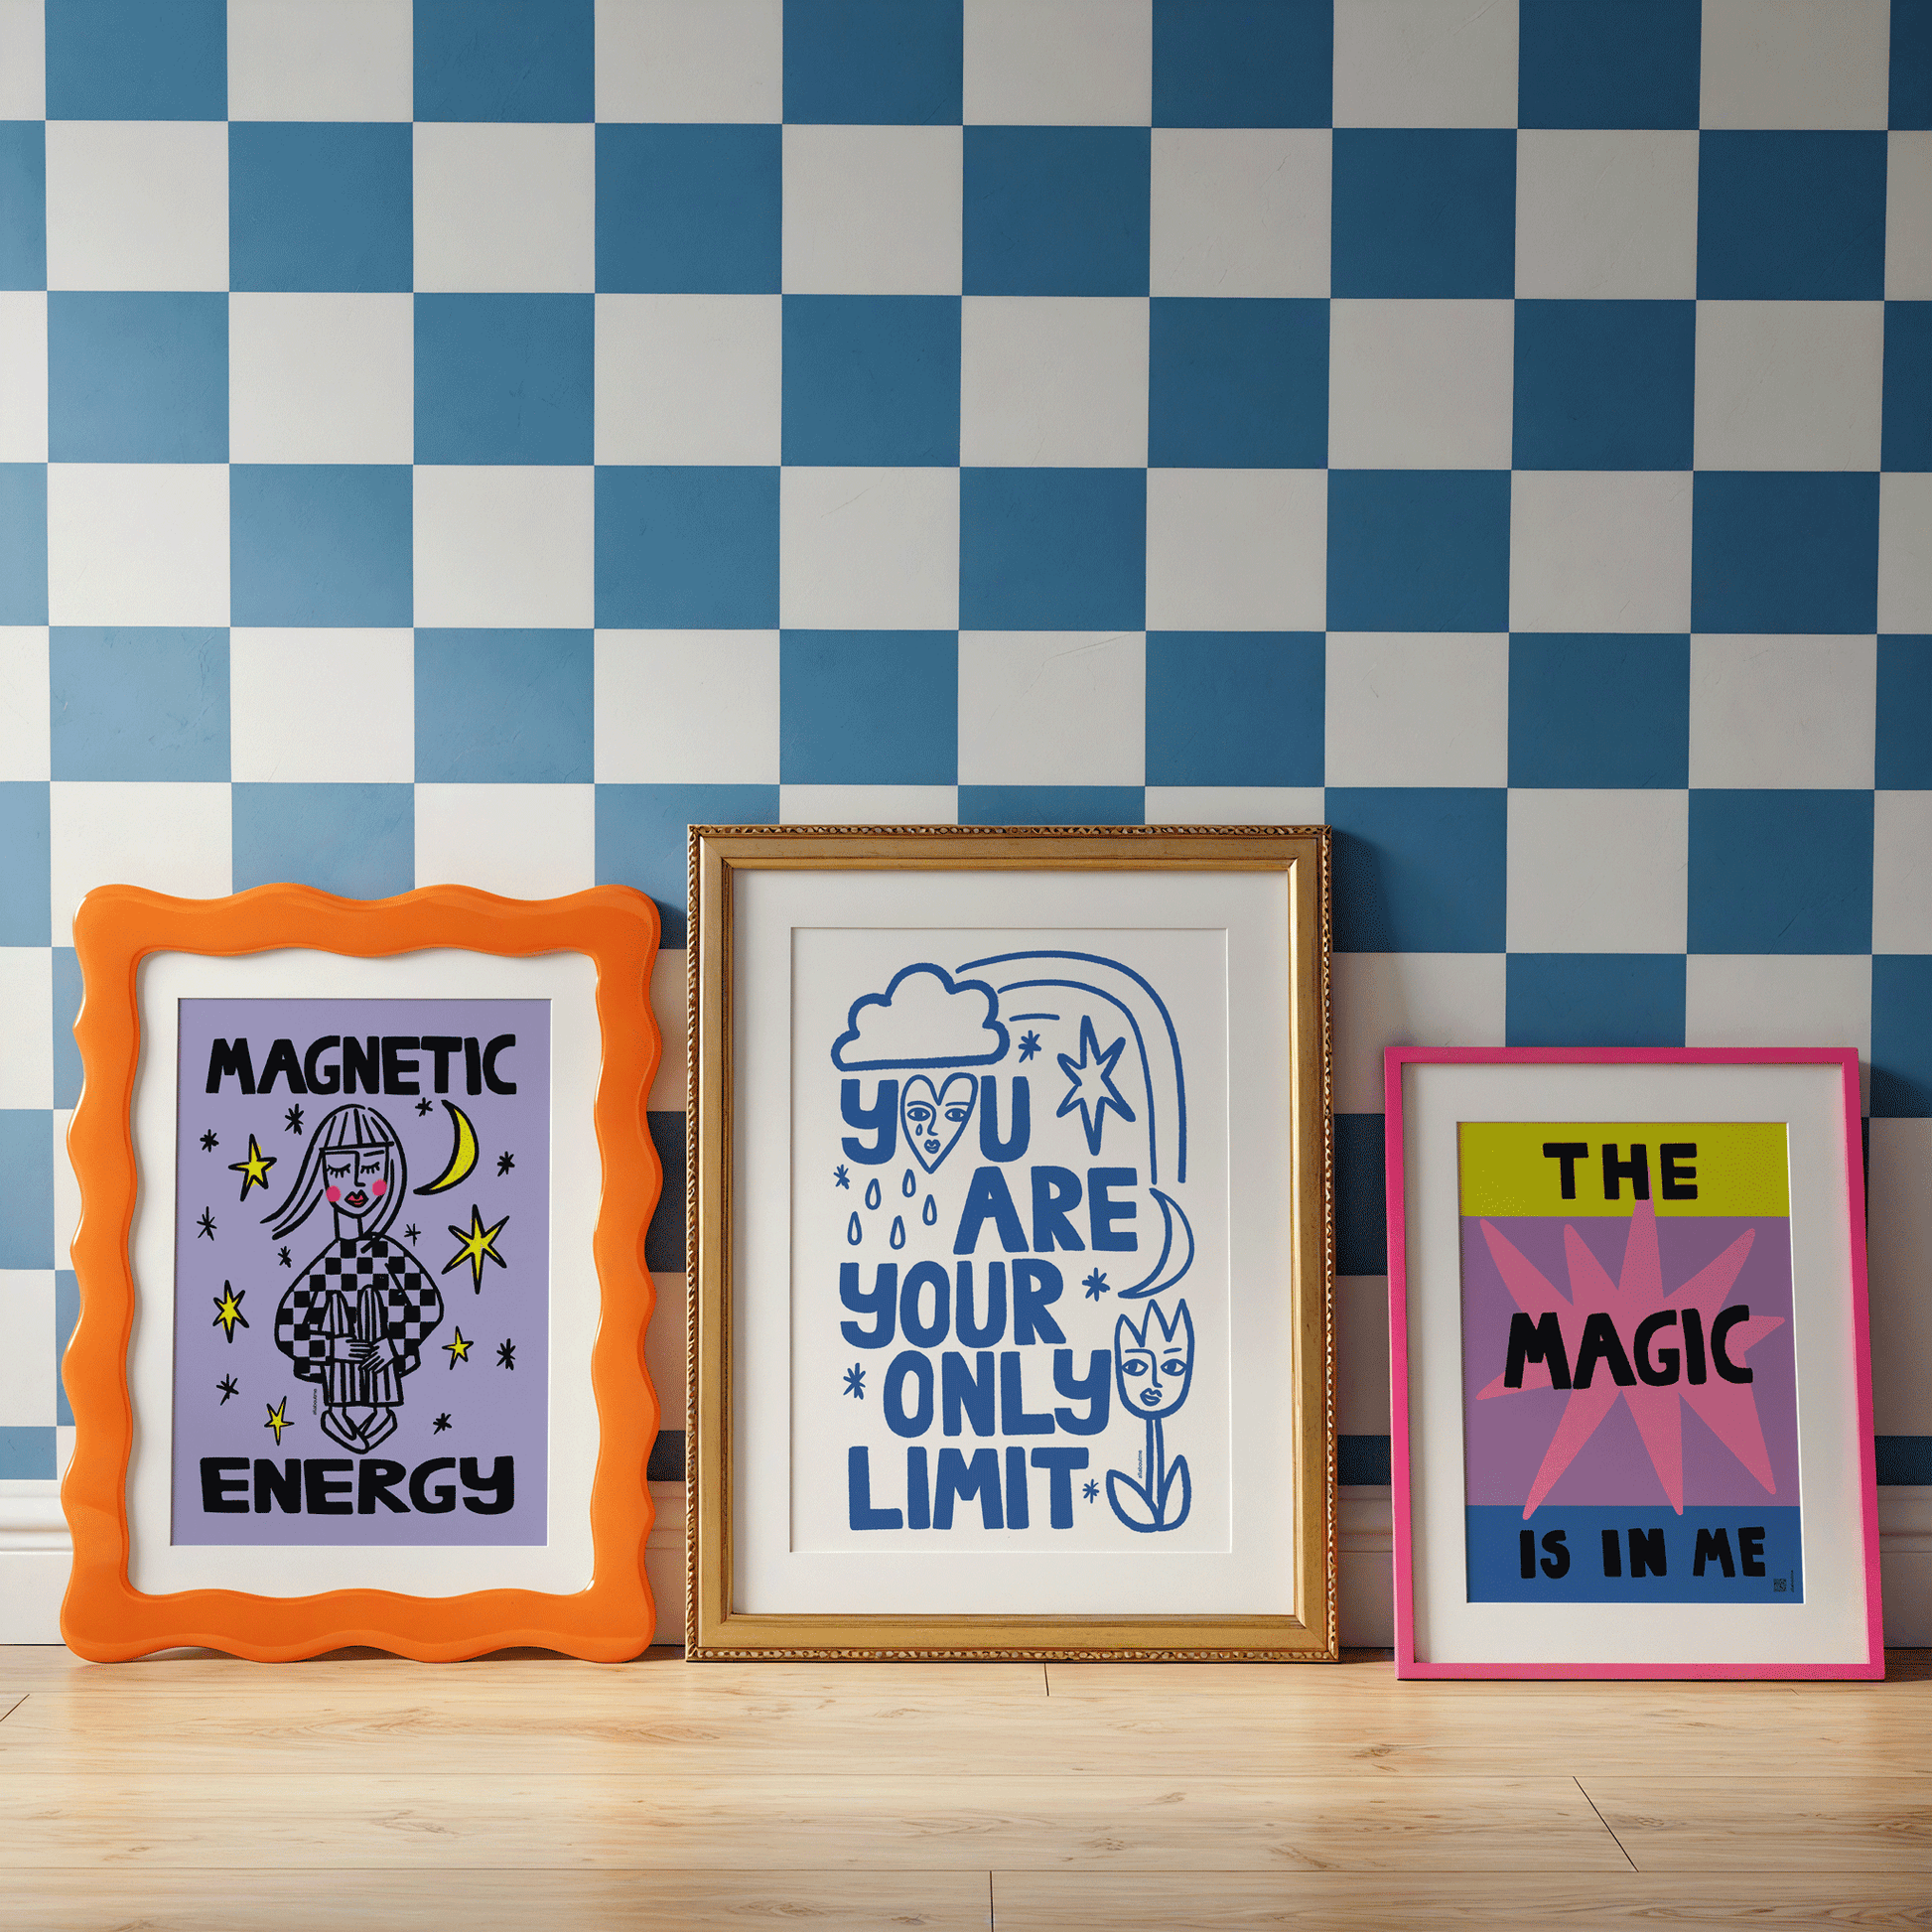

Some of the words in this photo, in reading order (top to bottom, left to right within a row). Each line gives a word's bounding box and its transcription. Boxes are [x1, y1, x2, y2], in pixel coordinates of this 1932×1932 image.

[206, 1034, 517, 1095] MAGNETIC
[953, 1166, 1138, 1255] ARE
[1542, 1142, 1699, 1200] THE
[840, 1258, 1066, 1349] YOUR
[1503, 1305, 1754, 1390] MAGIC
[883, 1348, 1112, 1438] ONLY
[200, 1454, 515, 1515] ENERGY
[848, 1446, 1089, 1530] LIMIT
[1519, 1529, 1571, 1580] IS
[1601, 1527, 1668, 1579] IN
[1693, 1526, 1766, 1578] ME
